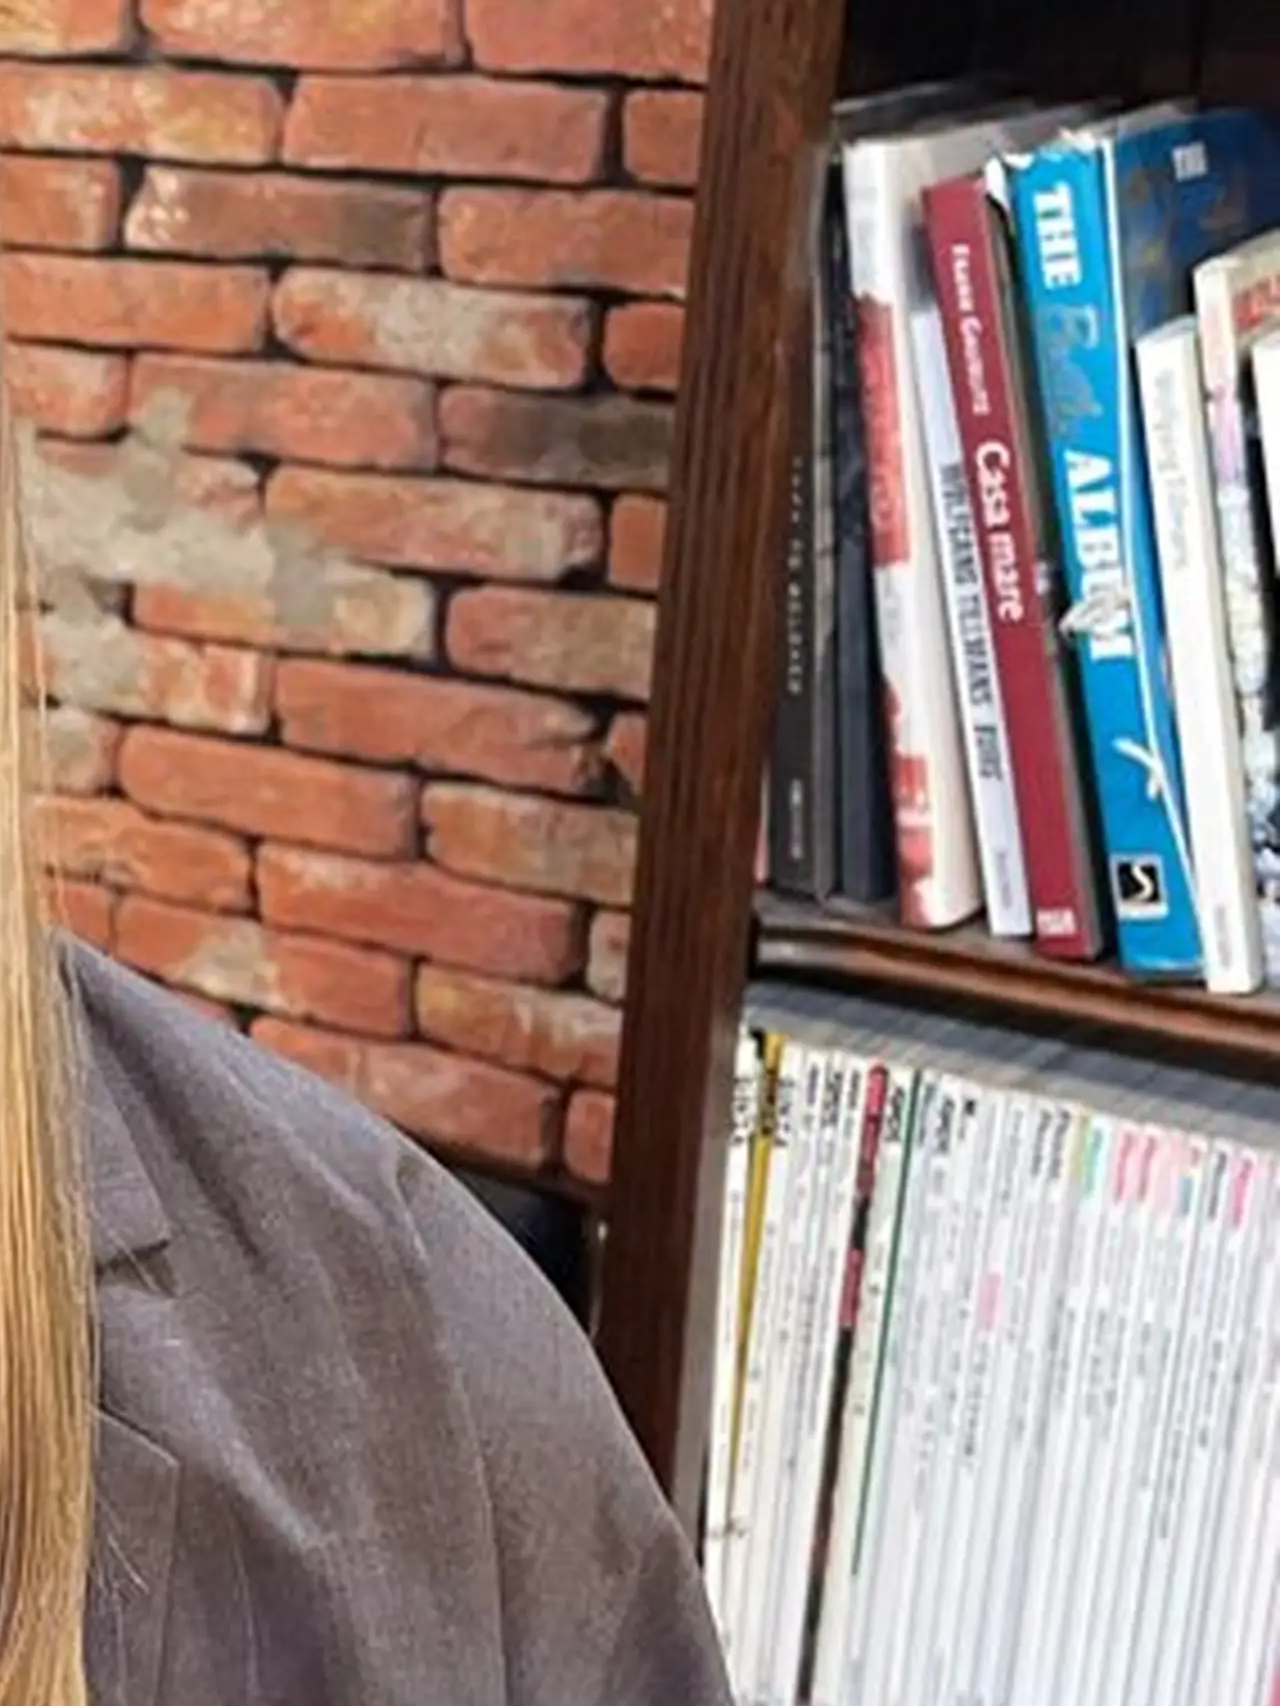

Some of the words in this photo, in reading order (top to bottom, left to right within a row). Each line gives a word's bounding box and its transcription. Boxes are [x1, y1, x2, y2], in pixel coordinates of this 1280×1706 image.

[1033, 179, 1083, 291] THE
[976, 441, 1011, 528] Casa
[987, 529, 1024, 622] mare
